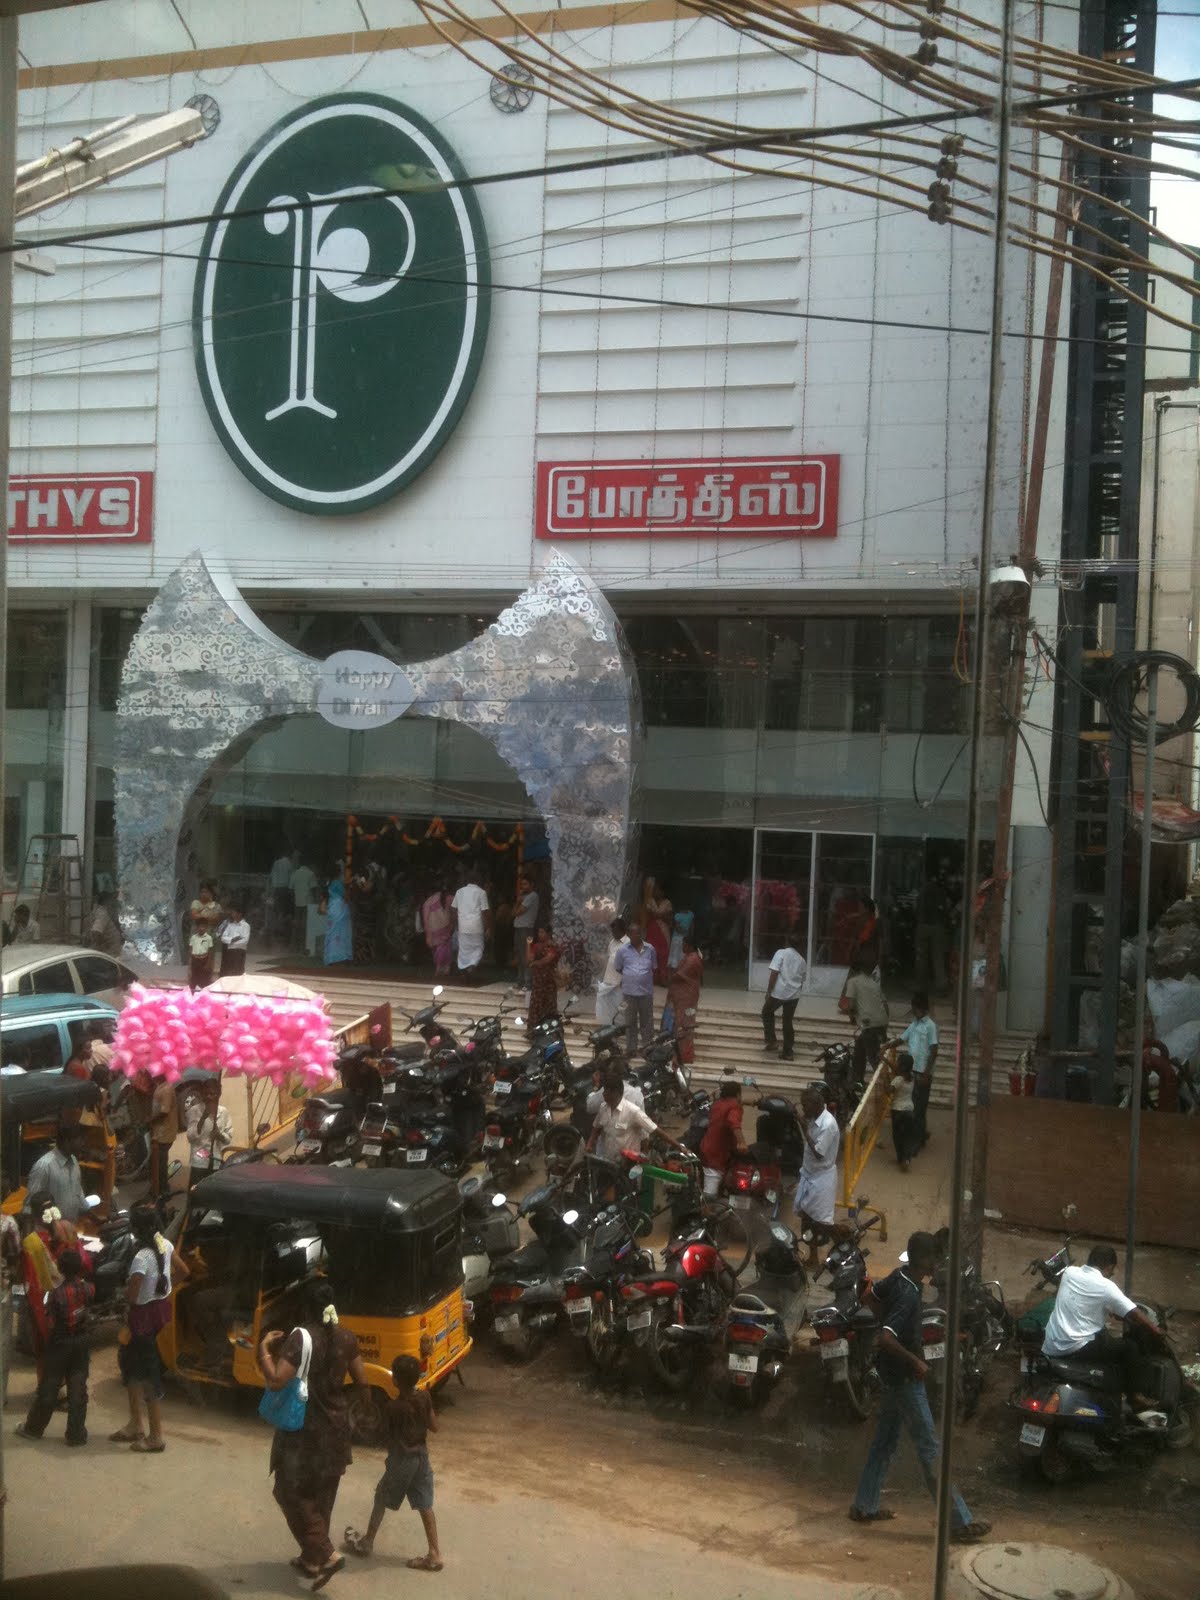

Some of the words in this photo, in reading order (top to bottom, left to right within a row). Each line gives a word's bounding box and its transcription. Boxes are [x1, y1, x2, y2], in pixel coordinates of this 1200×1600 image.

[7, 487, 130, 528] THYS
[556, 472, 816, 525] போத்தீஸ்
[335, 667, 394, 689] Happy
